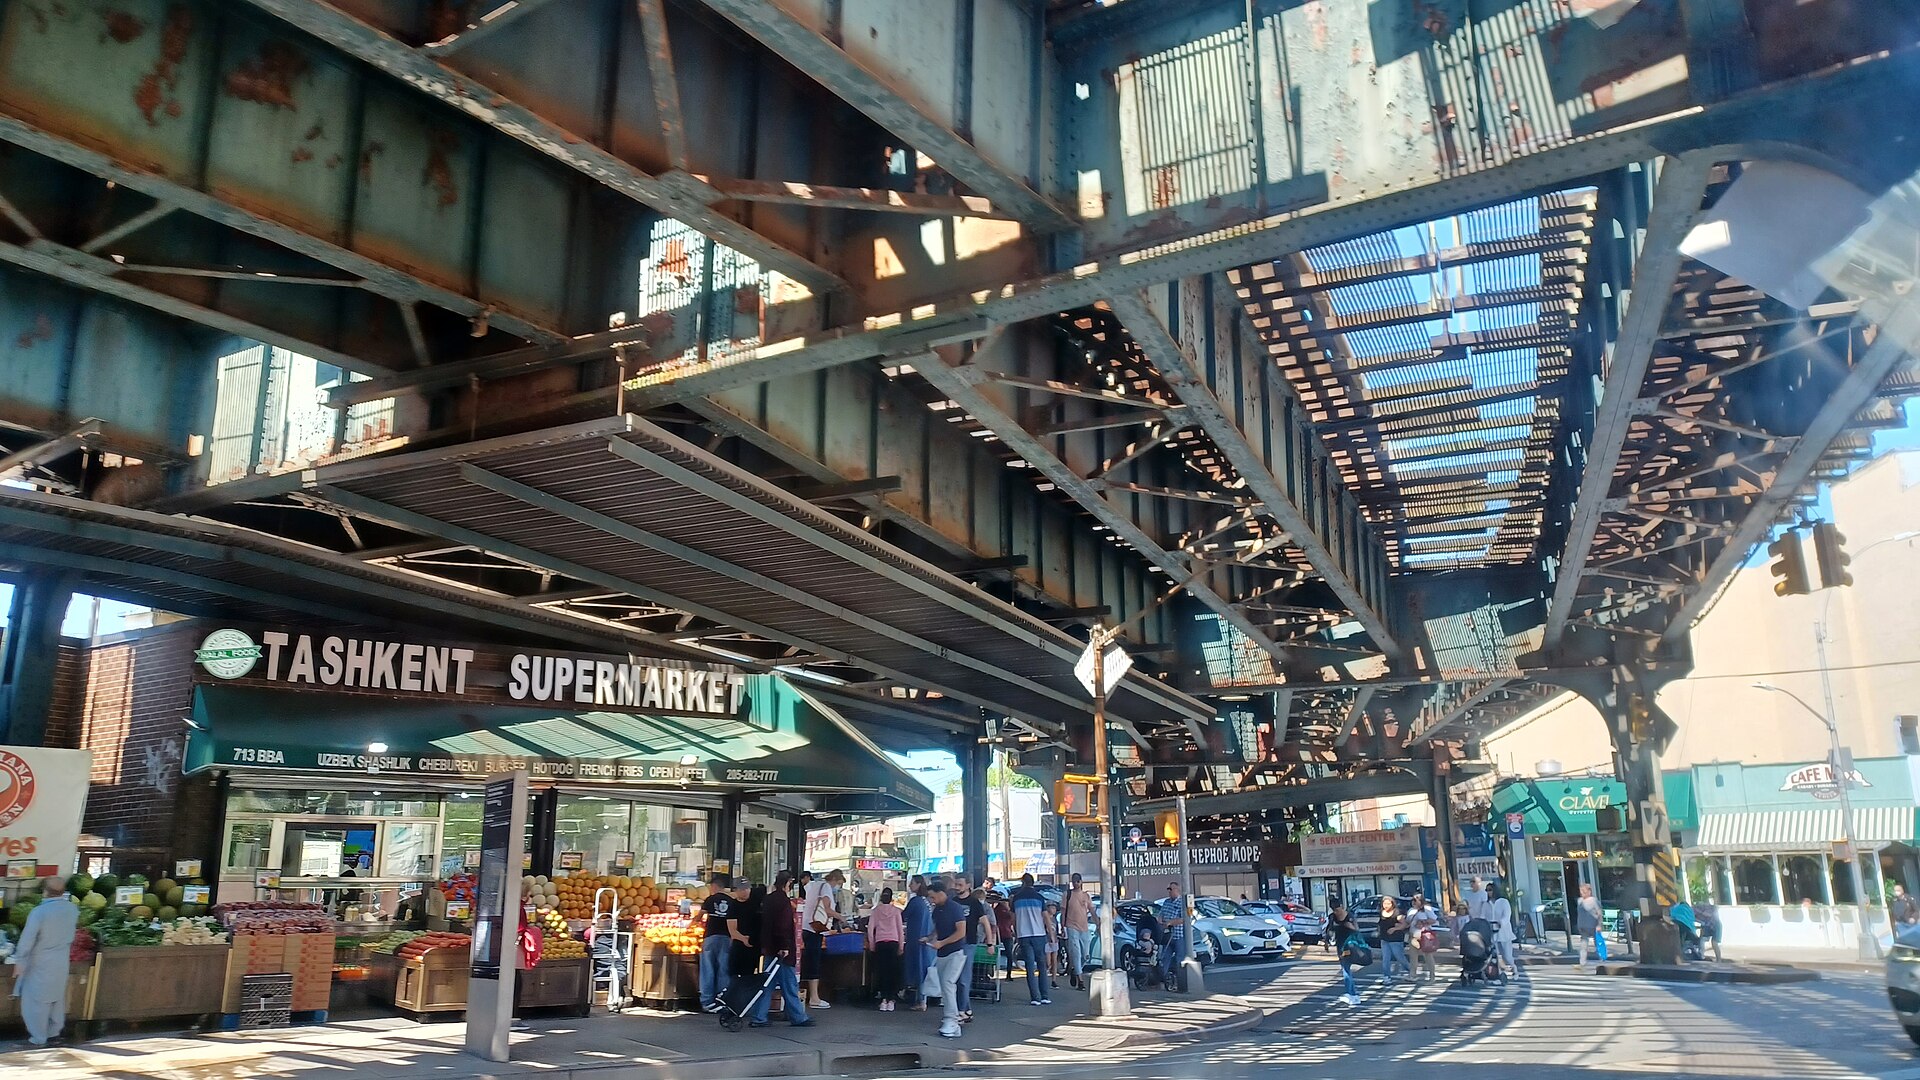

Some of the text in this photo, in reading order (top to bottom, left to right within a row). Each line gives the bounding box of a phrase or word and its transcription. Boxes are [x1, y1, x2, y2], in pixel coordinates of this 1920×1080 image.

[263, 631, 744, 715] TASHKENT SUPERMARKET
[233, 748, 285, 763] 713 BBA
[317, 753, 355, 767] UZBEK
[357, 755, 411, 769] SHASHLIK
[419, 758, 479, 771] CHEBUREKI
[533, 762, 573, 775] HOTDOG
[579, 763, 616, 776] FRENCH
[618, 765, 643, 777] FRIES
[649, 766, 673, 778] OPEN
[676, 767, 708, 779] BUFFET
[1791, 766, 1856, 784] CAFE MX
[1320, 832, 1396, 846] SERVICE CENTER
[1122, 851, 1161, 868] МАГАЗИН
[1191, 847, 1229, 864] ЧЕРНОЕ
[1232, 845, 1260, 862] МОРЕ
[855, 860, 906, 870] HALAL FOOD
[1123, 869, 1137, 877] BLACK
[1151, 867, 1181, 875] BOOKSTORE
[1468, 862, 1496, 874] ESTATE
